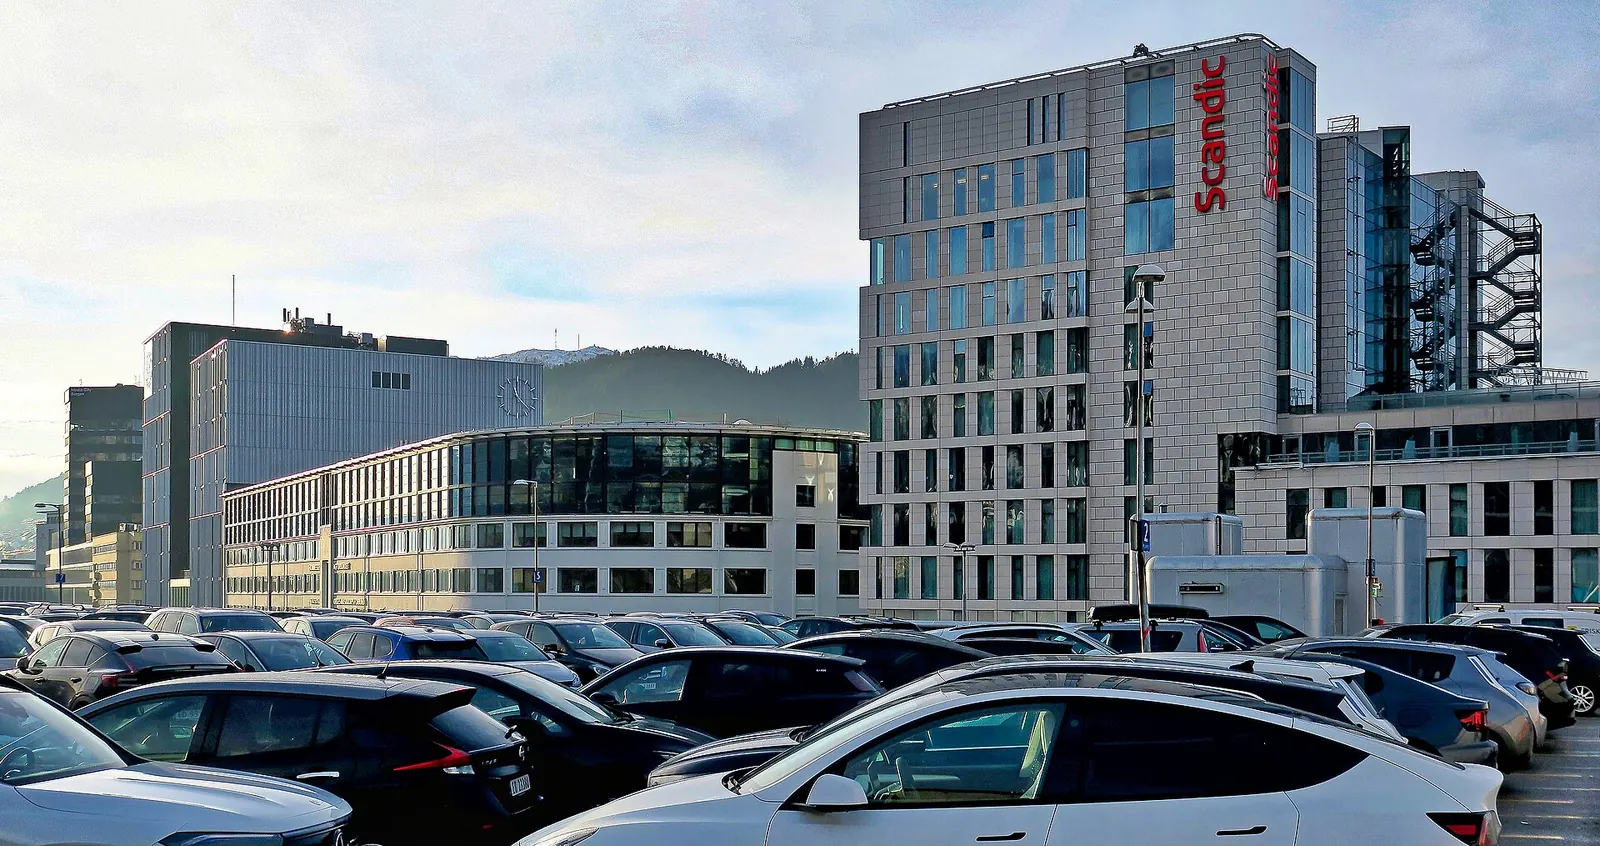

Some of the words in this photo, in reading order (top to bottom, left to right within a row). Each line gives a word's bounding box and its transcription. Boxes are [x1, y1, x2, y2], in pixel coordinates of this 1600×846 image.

[1193, 55, 1226, 213] Scandic
[1264, 52, 1280, 201] Scandic
[1143, 522, 1149, 543] 2
